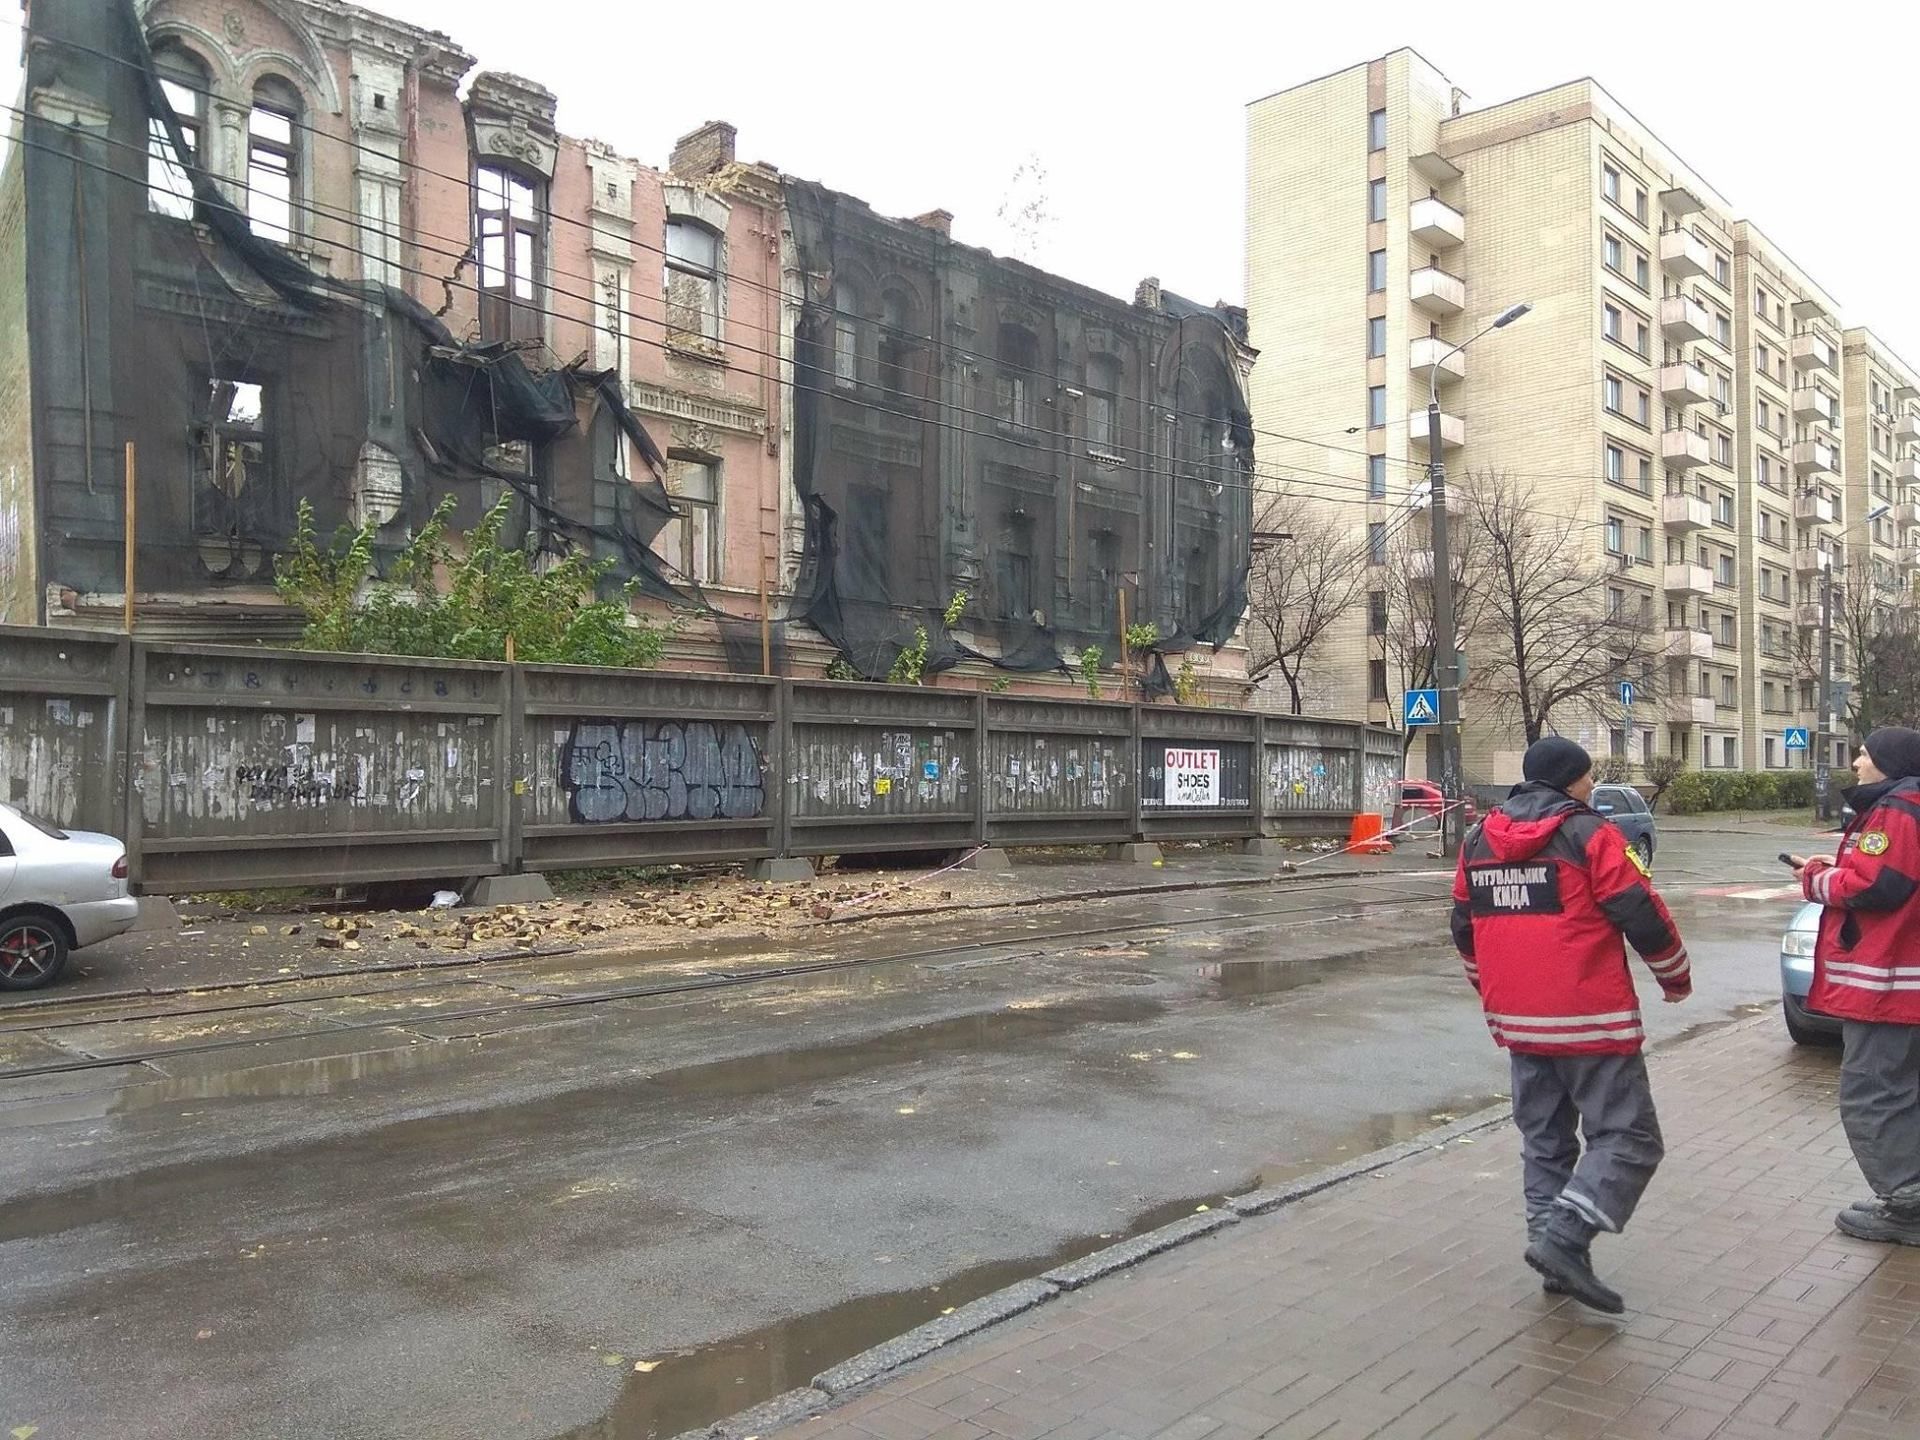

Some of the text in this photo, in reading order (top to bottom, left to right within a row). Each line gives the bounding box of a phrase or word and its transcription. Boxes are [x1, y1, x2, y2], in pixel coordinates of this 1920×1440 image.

[1166, 751, 1217, 769] OUTLET
[1177, 773, 1210, 788] SHOES
[1471, 866, 1547, 887] РЯТУВАЛЬНИК
[1493, 885, 1530, 910] КИДА
